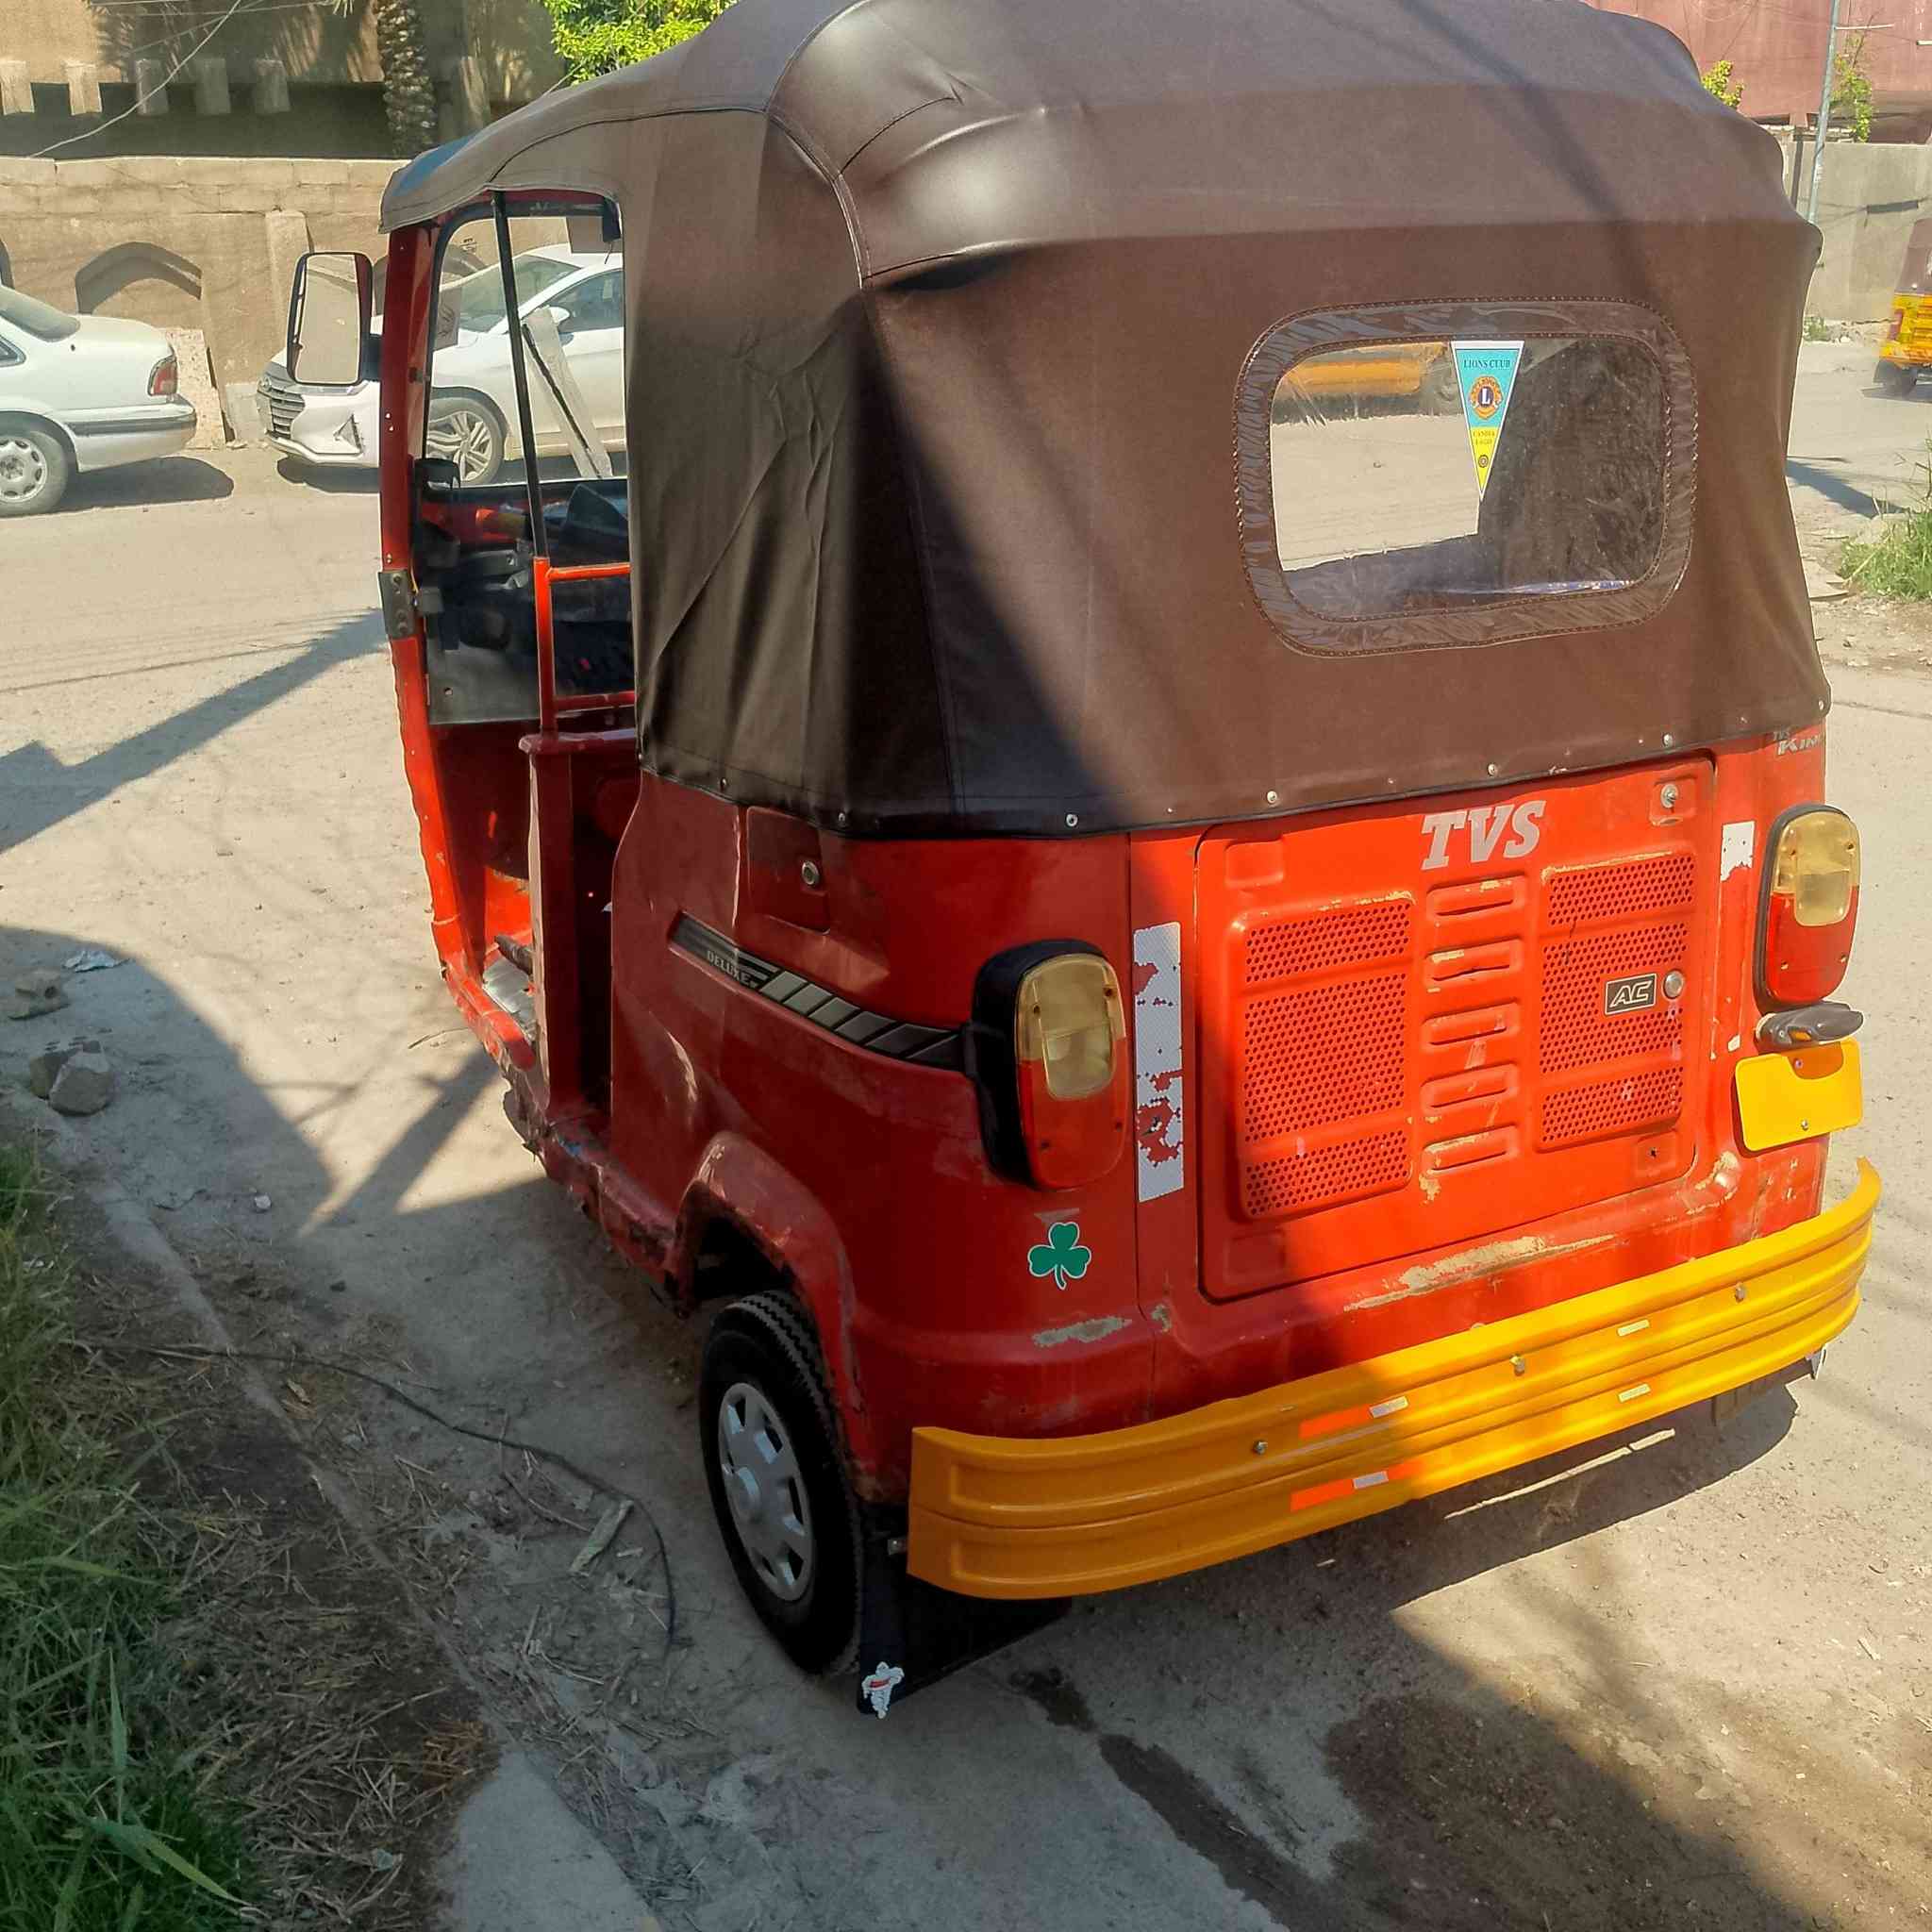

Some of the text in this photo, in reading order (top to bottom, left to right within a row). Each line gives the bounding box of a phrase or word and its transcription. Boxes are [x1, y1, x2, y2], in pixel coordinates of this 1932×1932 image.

[1463, 358, 1510, 369] LIONS CLUB
[1481, 388, 1491, 405] L
[1421, 800, 1547, 871] TVS
[706, 949, 753, 986] DELUXE
[1609, 980, 1653, 1008] AC
